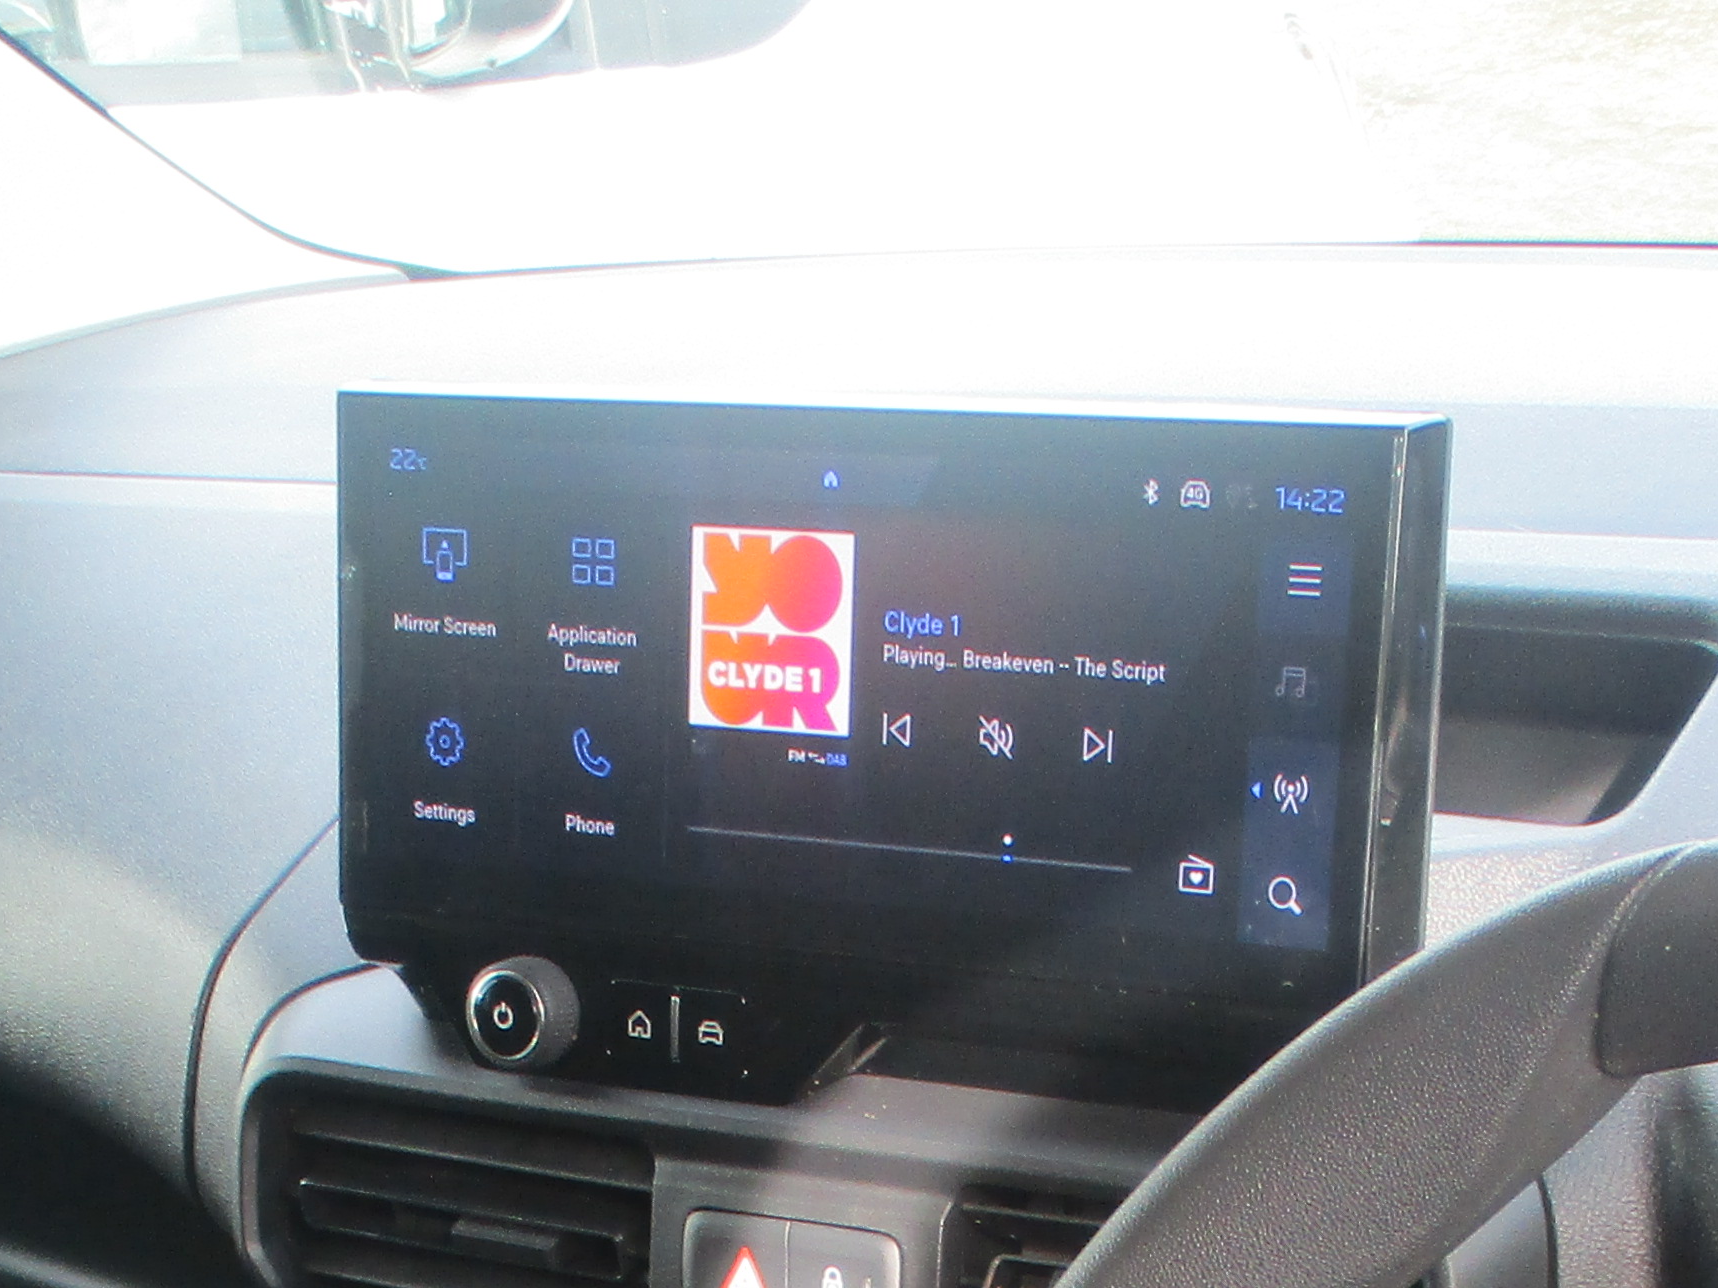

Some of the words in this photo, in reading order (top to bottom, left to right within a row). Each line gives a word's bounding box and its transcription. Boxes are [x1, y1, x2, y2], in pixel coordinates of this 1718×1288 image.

[1276, 486, 1345, 514] 14:22
[393, 612, 440, 636] Mirror
[443, 616, 498, 639] Screen
[547, 623, 637, 651] Application
[884, 611, 944, 639] Clyde
[951, 614, 961, 637] 1
[564, 653, 621, 676] Drawer
[708, 660, 803, 692] CLYDE
[808, 667, 823, 693] 1
[963, 648, 1055, 675] Breakeven
[1074, 655, 1108, 679] The
[1111, 659, 1167, 685] Script
[413, 799, 477, 826] Settings
[564, 813, 615, 837] Phone
